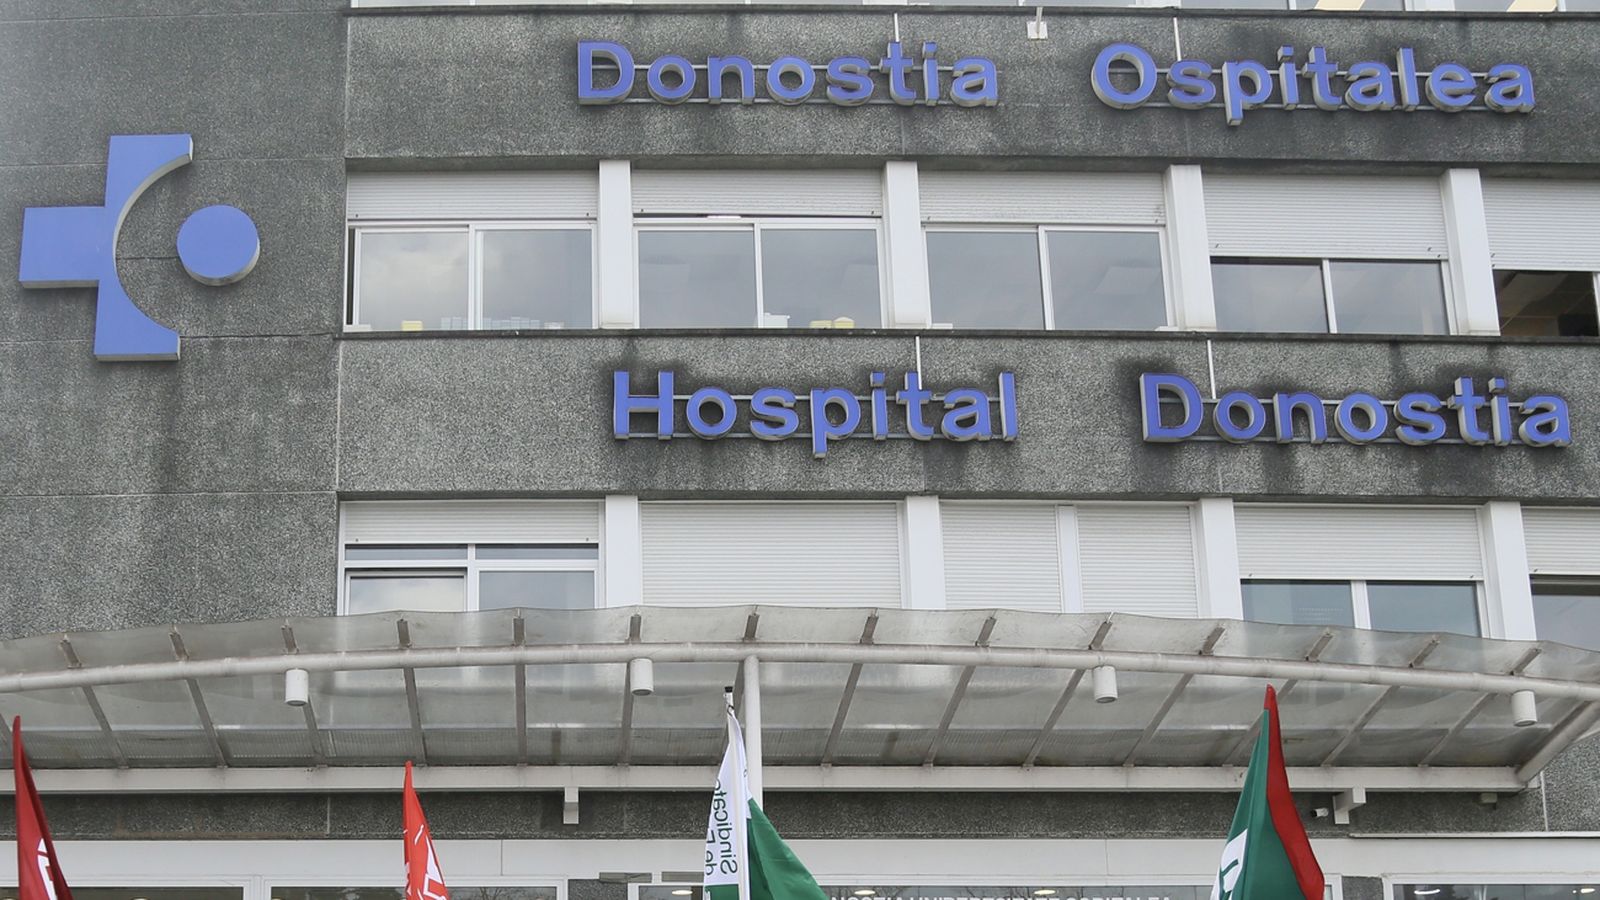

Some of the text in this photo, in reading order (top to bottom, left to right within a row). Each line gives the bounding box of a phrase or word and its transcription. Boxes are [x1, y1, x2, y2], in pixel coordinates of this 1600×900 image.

[577, 41, 1536, 126] Donostia Ospitalea
[613, 371, 1572, 458] Hospital Donostia
